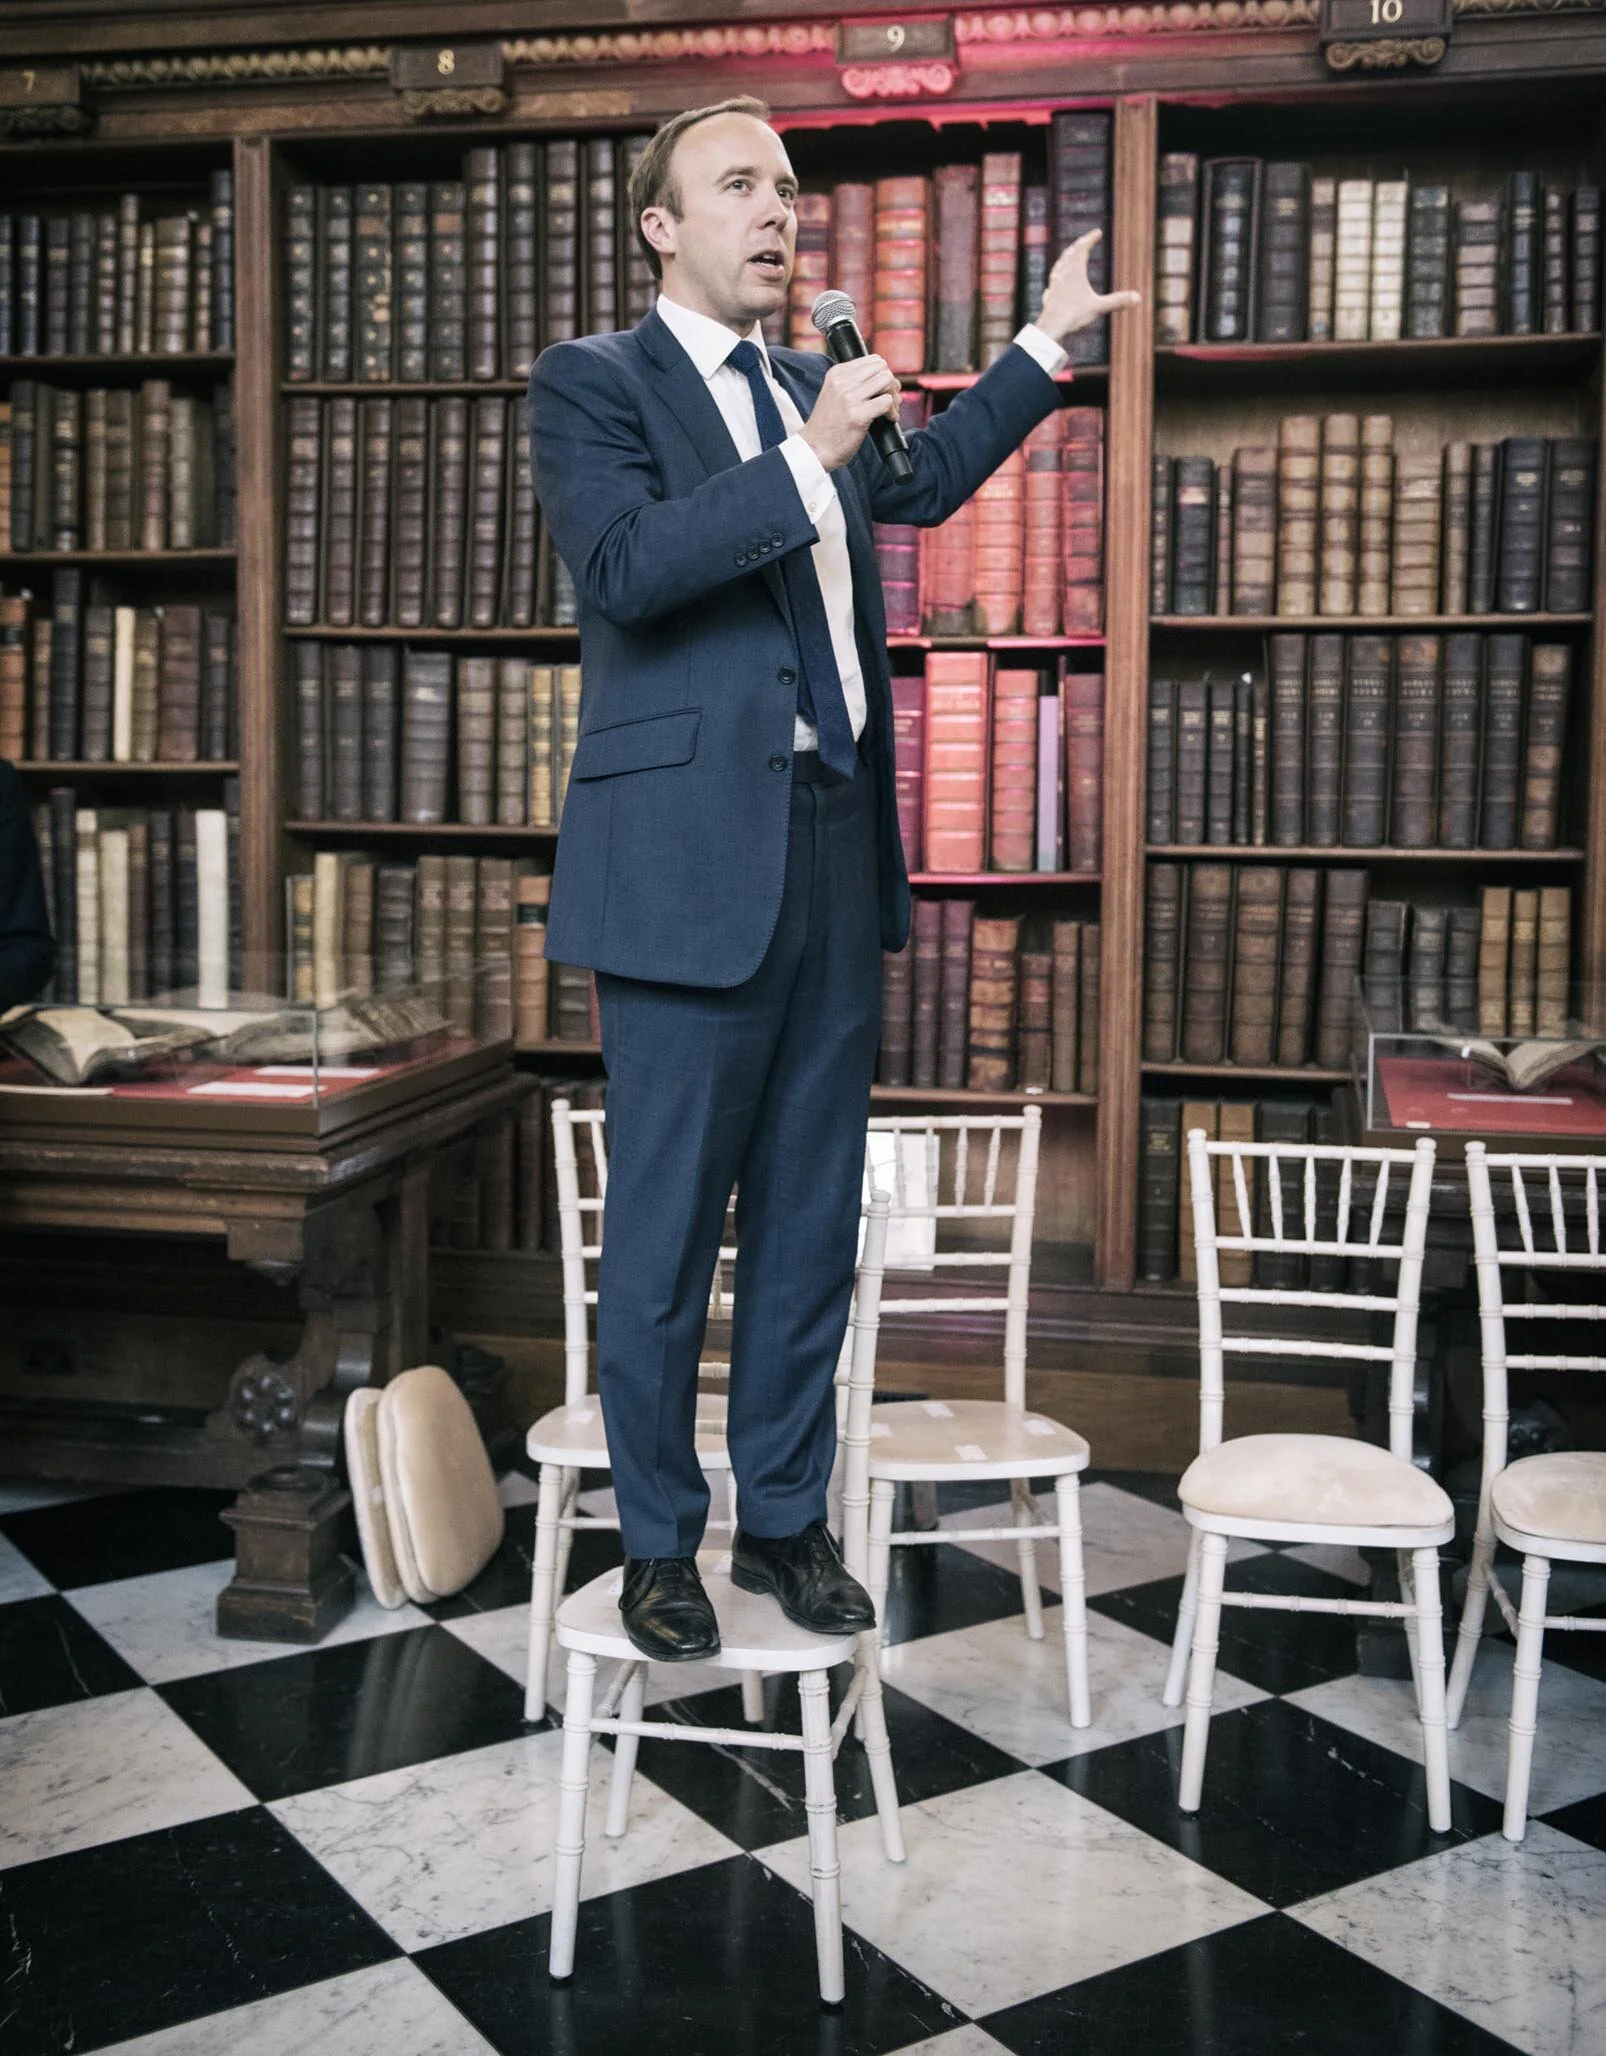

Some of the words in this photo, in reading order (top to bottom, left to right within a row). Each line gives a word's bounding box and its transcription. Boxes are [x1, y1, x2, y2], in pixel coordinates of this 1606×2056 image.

[1370, 0, 1403, 24] 10
[886, 24, 905, 52] 9
[438, 48, 455, 75] 8
